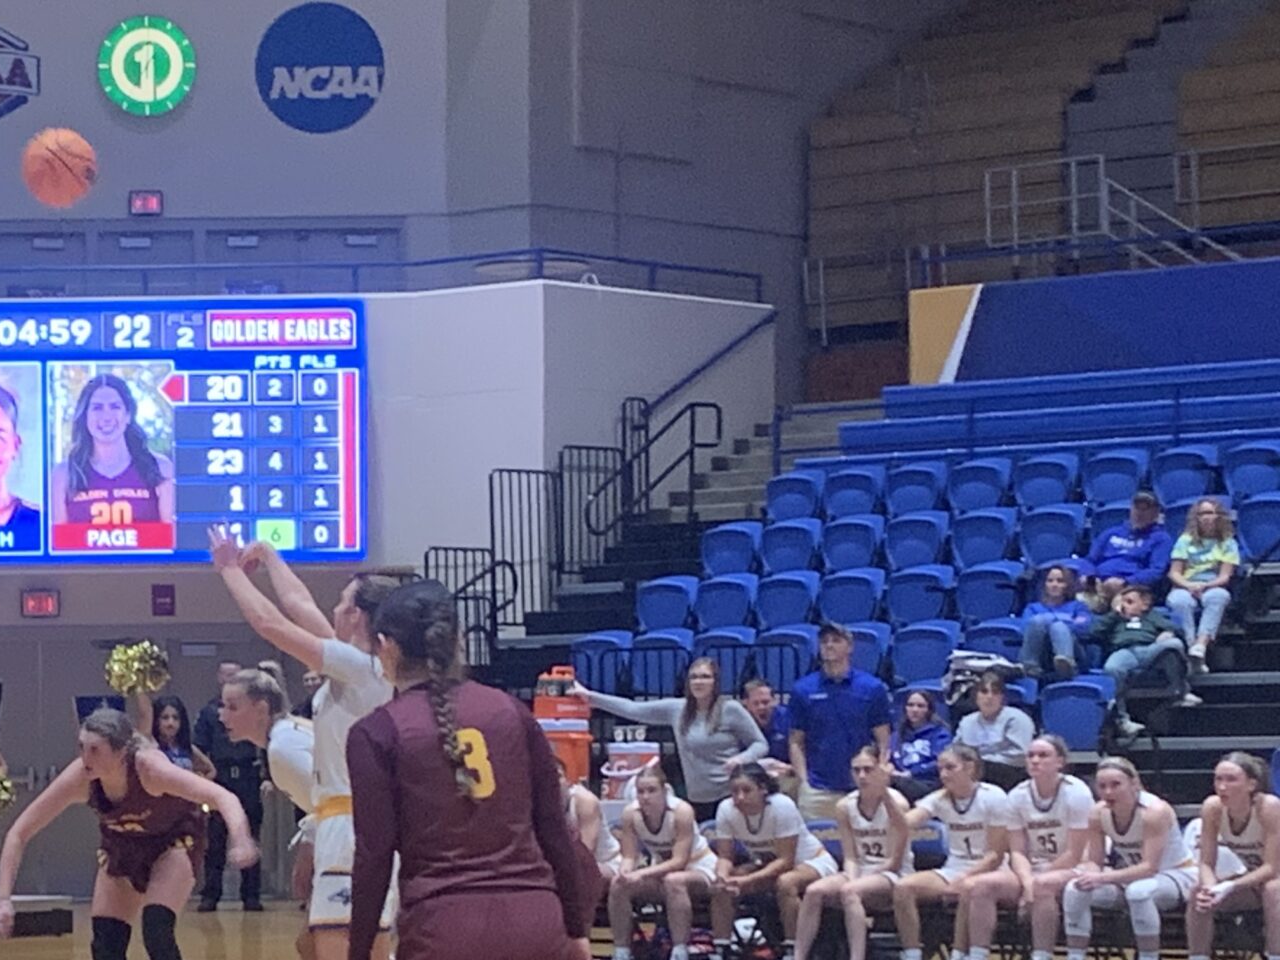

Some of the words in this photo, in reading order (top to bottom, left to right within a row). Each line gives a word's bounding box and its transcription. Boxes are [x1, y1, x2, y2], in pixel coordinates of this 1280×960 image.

[270, 66, 379, 99] NCAA
[113, 314, 151, 349] 22
[176, 327, 195, 348] 2
[211, 319, 279, 343] GOLDEN
[284, 318, 351, 342] EAGLES
[254, 355, 291, 368] PTS
[299, 355, 337, 368] FLS
[207, 376, 243, 401] 20
[268, 379, 282, 397] 2
[313, 378, 327, 396] 0
[212, 413, 243, 438] 21
[269, 415, 282, 433] 3
[314, 415, 328, 433] 1
[207, 450, 244, 475] 23
[268, 452, 283, 471] 4
[314, 452, 328, 470] 1
[229, 486, 244, 511] 1
[269, 489, 283, 507] 2
[314, 488, 328, 506] 1
[87, 529, 138, 547] PAGE
[271, 528, 281, 542] 6
[314, 525, 328, 543] 0
[455, 727, 497, 800] 3
